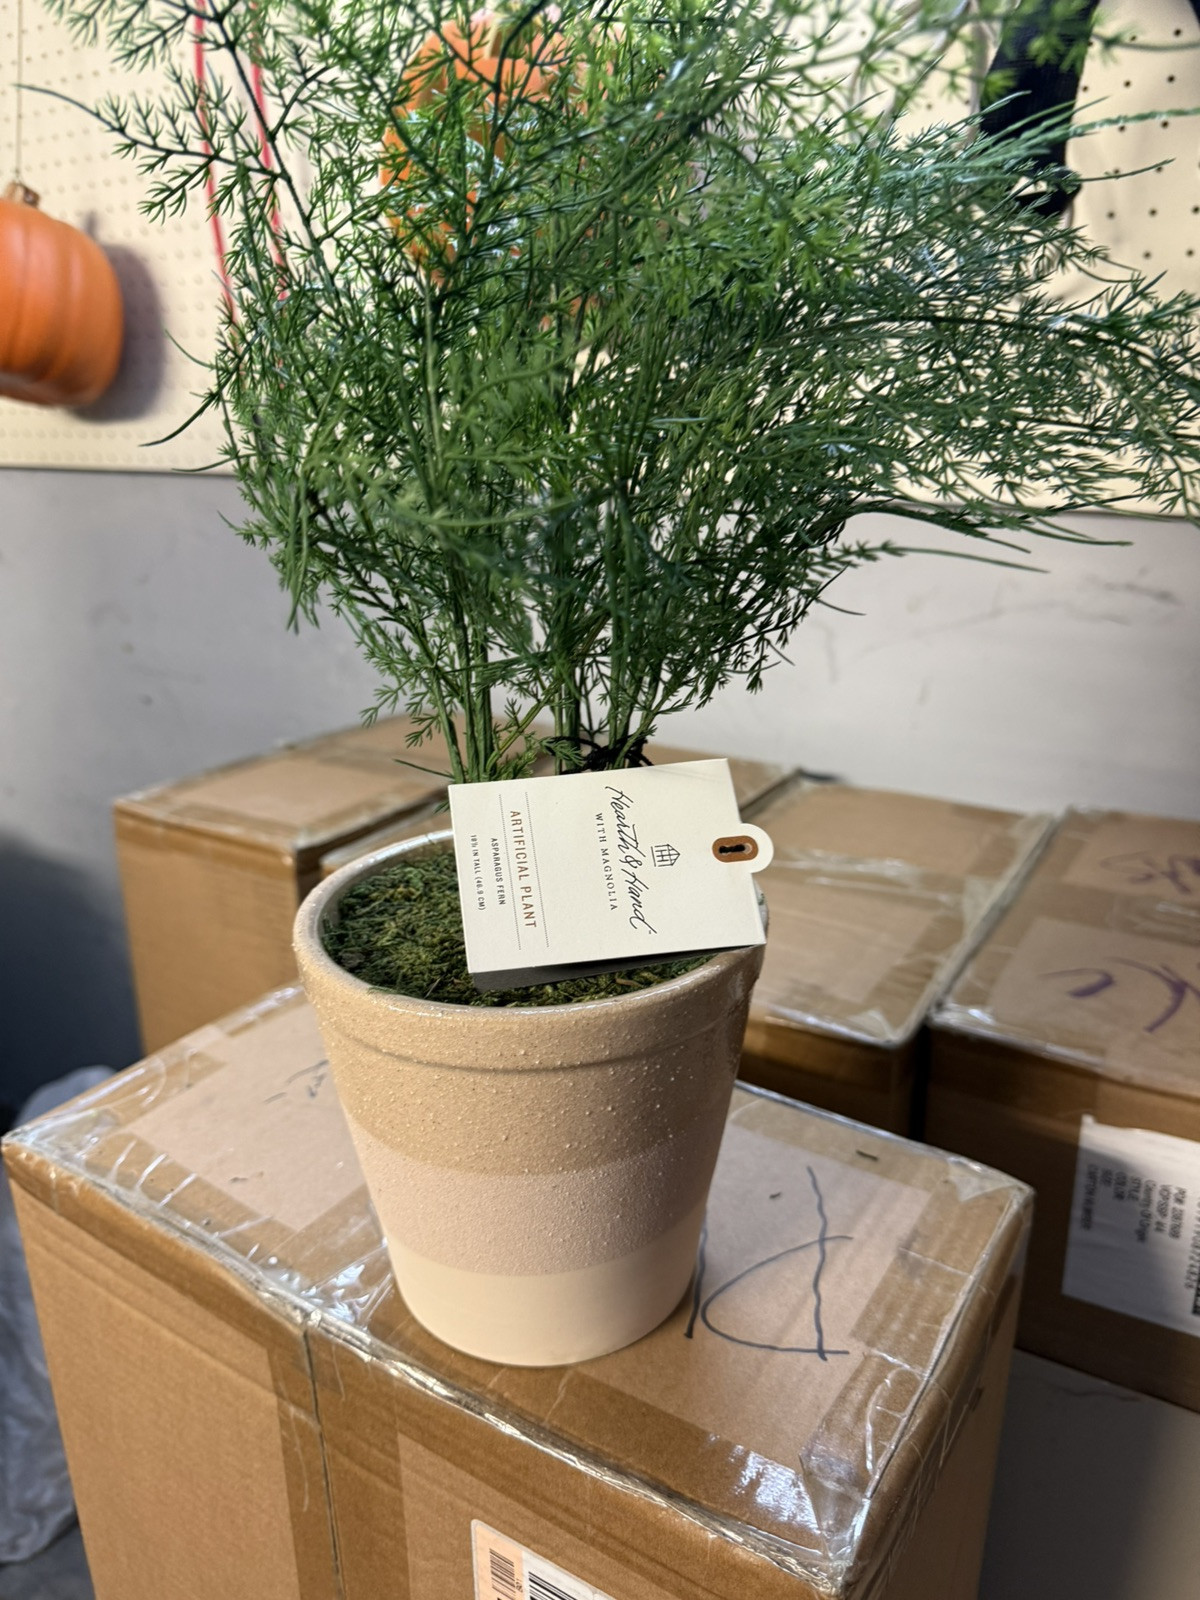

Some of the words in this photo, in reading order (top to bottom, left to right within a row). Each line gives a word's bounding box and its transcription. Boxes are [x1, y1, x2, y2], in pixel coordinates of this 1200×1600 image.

[595, 813, 607, 843] WITH
[605, 786, 646, 857] Hearth
[473, 849, 479, 857] IN
[491, 838, 504, 883] ASPARAGUS
[619, 855, 643, 869] &
[473, 859, 481, 874] TALL
[510, 811, 530, 881] ARTIFICIAL
[520, 886, 537, 928] PLANT
[600, 848, 618, 911] MAGNOLIA
[477, 897, 486, 911] CM)
[496, 885, 506, 905] FERN
